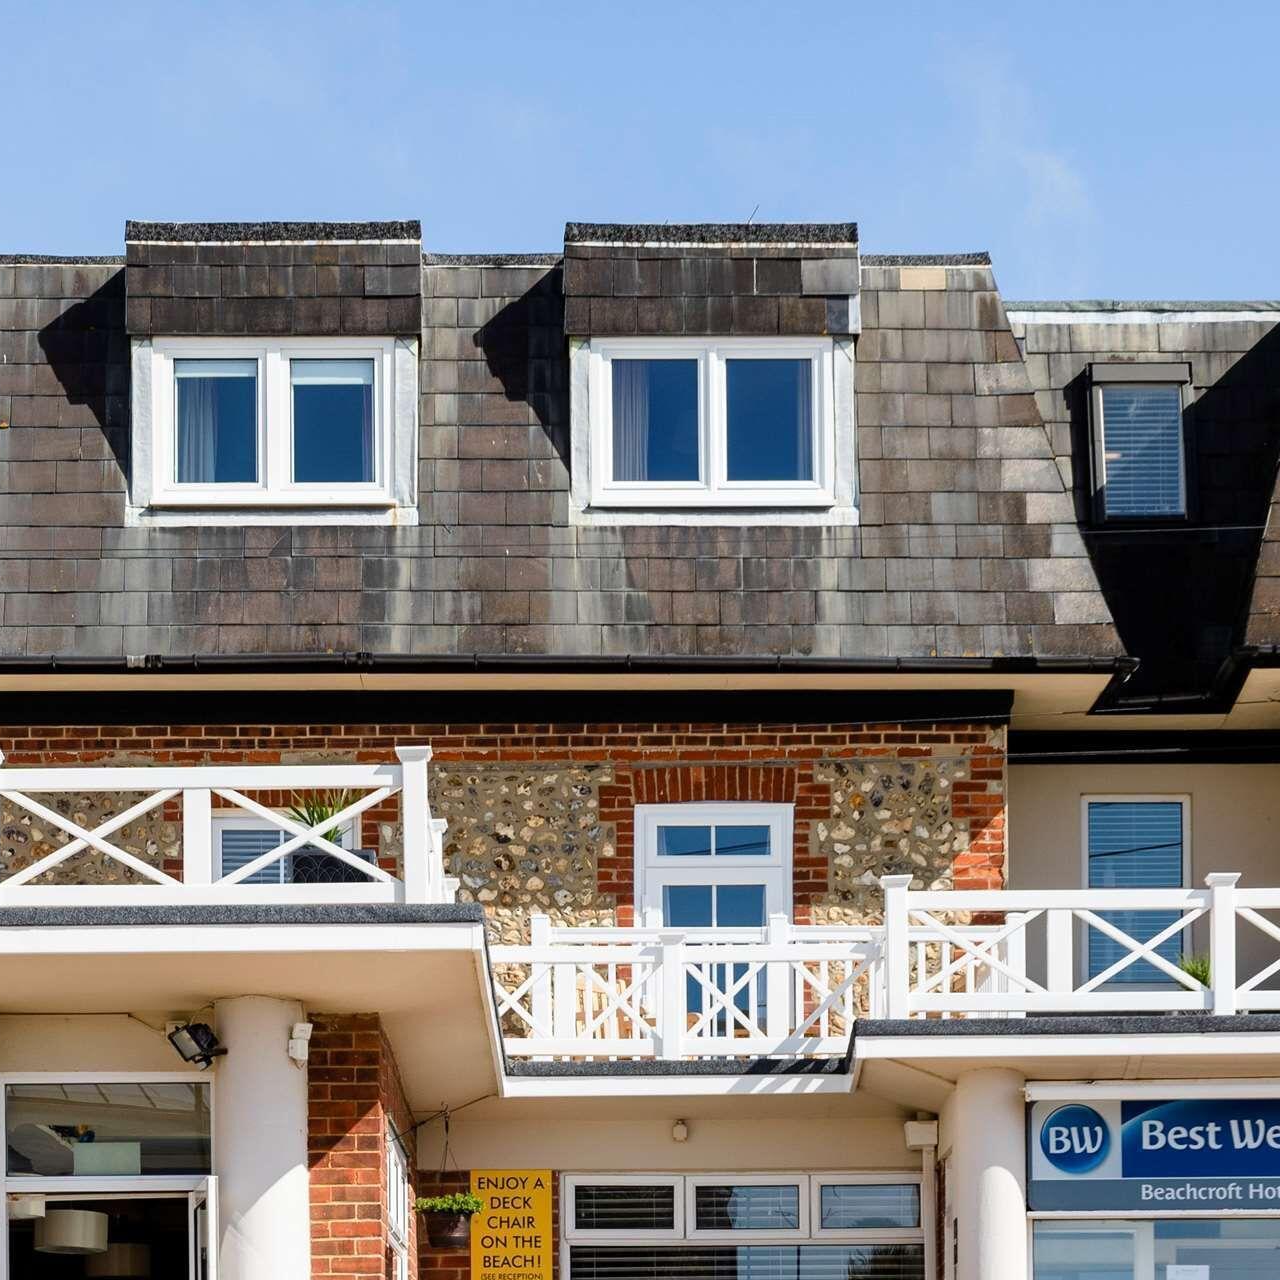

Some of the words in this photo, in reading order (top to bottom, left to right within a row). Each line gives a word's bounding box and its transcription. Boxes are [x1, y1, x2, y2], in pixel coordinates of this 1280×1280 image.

[1048, 1126, 1104, 1155] BW
[1141, 1119, 1222, 1151] Best
[477, 1176, 529, 1190] ENJOY
[533, 1176, 545, 1190] A
[1140, 1182, 1243, 1201] Beachcroft
[490, 1196, 533, 1209] DECK
[487, 1215, 536, 1229] CHAIR
[480, 1235, 508, 1249] ON
[513, 1235, 542, 1248] THE
[480, 1272, 496, 1280] (SEE
[498, 1272, 544, 1280] RECEPTION)
